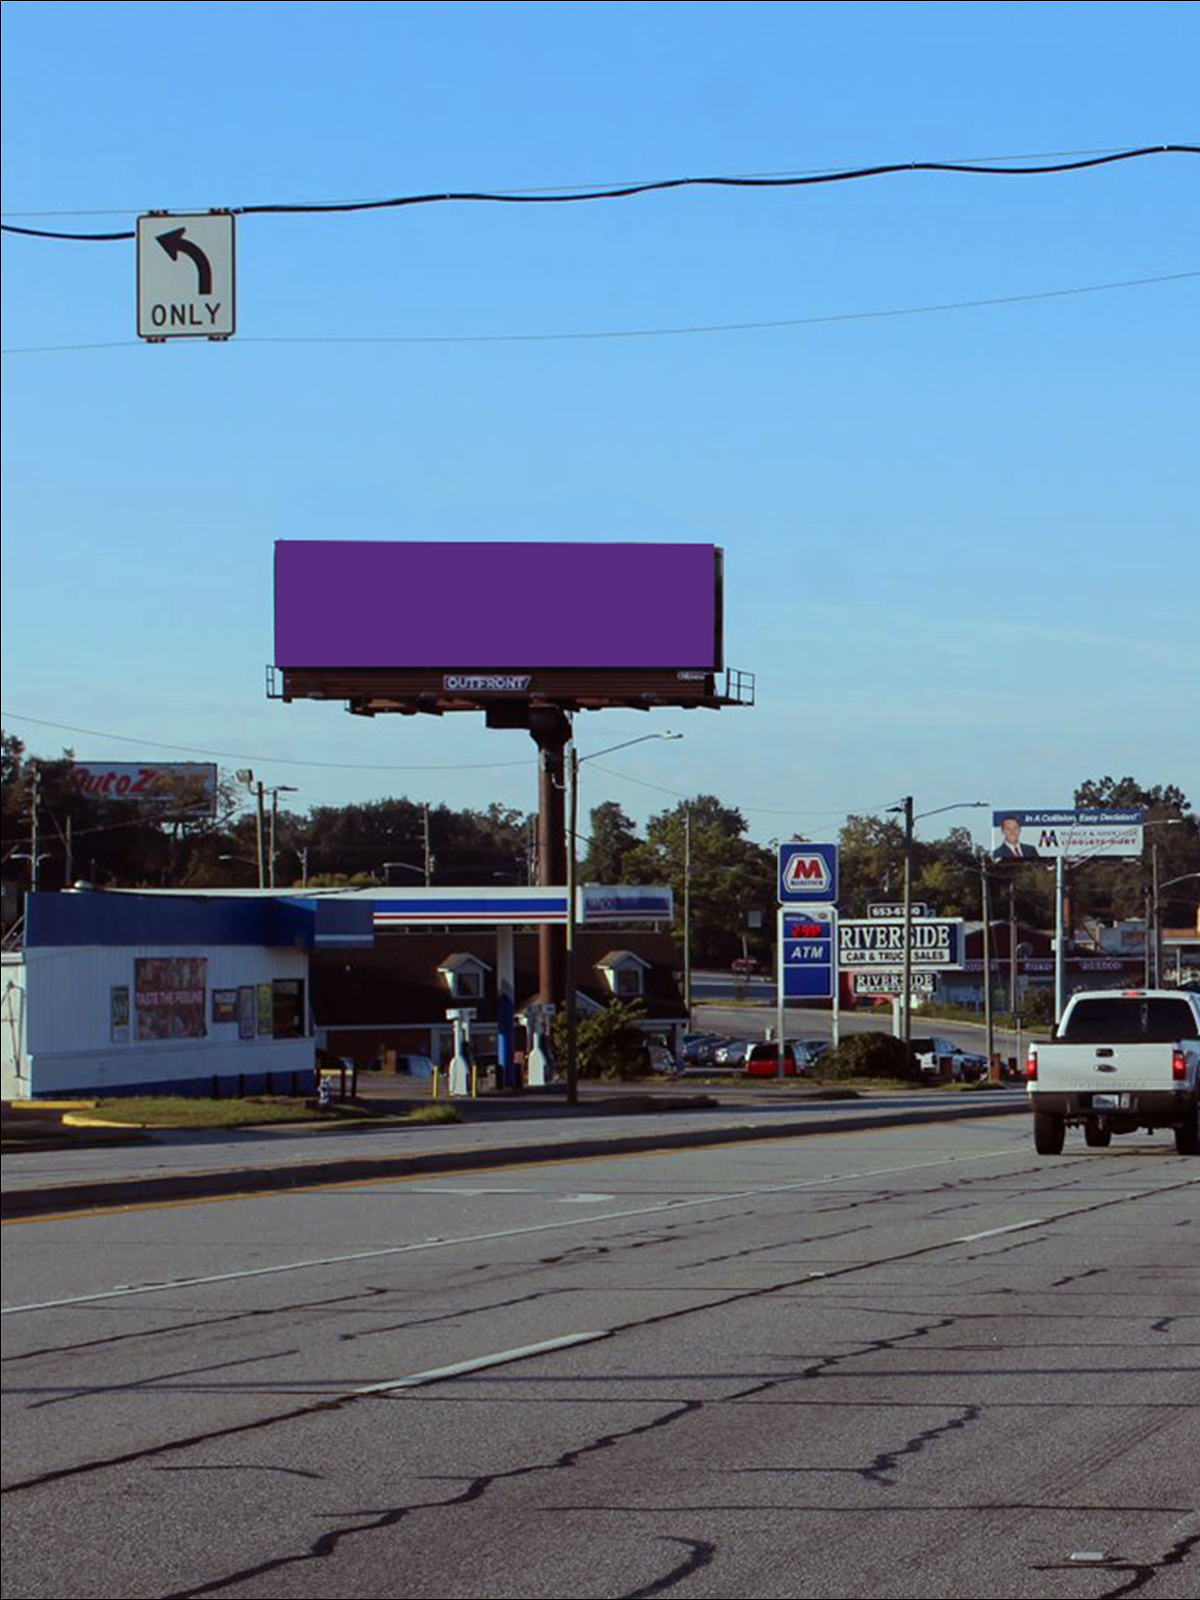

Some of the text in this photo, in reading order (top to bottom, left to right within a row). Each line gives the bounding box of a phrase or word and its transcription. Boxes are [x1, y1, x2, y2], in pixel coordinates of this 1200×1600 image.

[151, 302, 221, 327] ONLY
[446, 676, 528, 690] OUTFRONT
[1079, 813, 1098, 823] Easy
[790, 946, 823, 959] ATM
[846, 951, 945, 962] CAR & TRUC SALES
[160, 992, 174, 1005] THE
